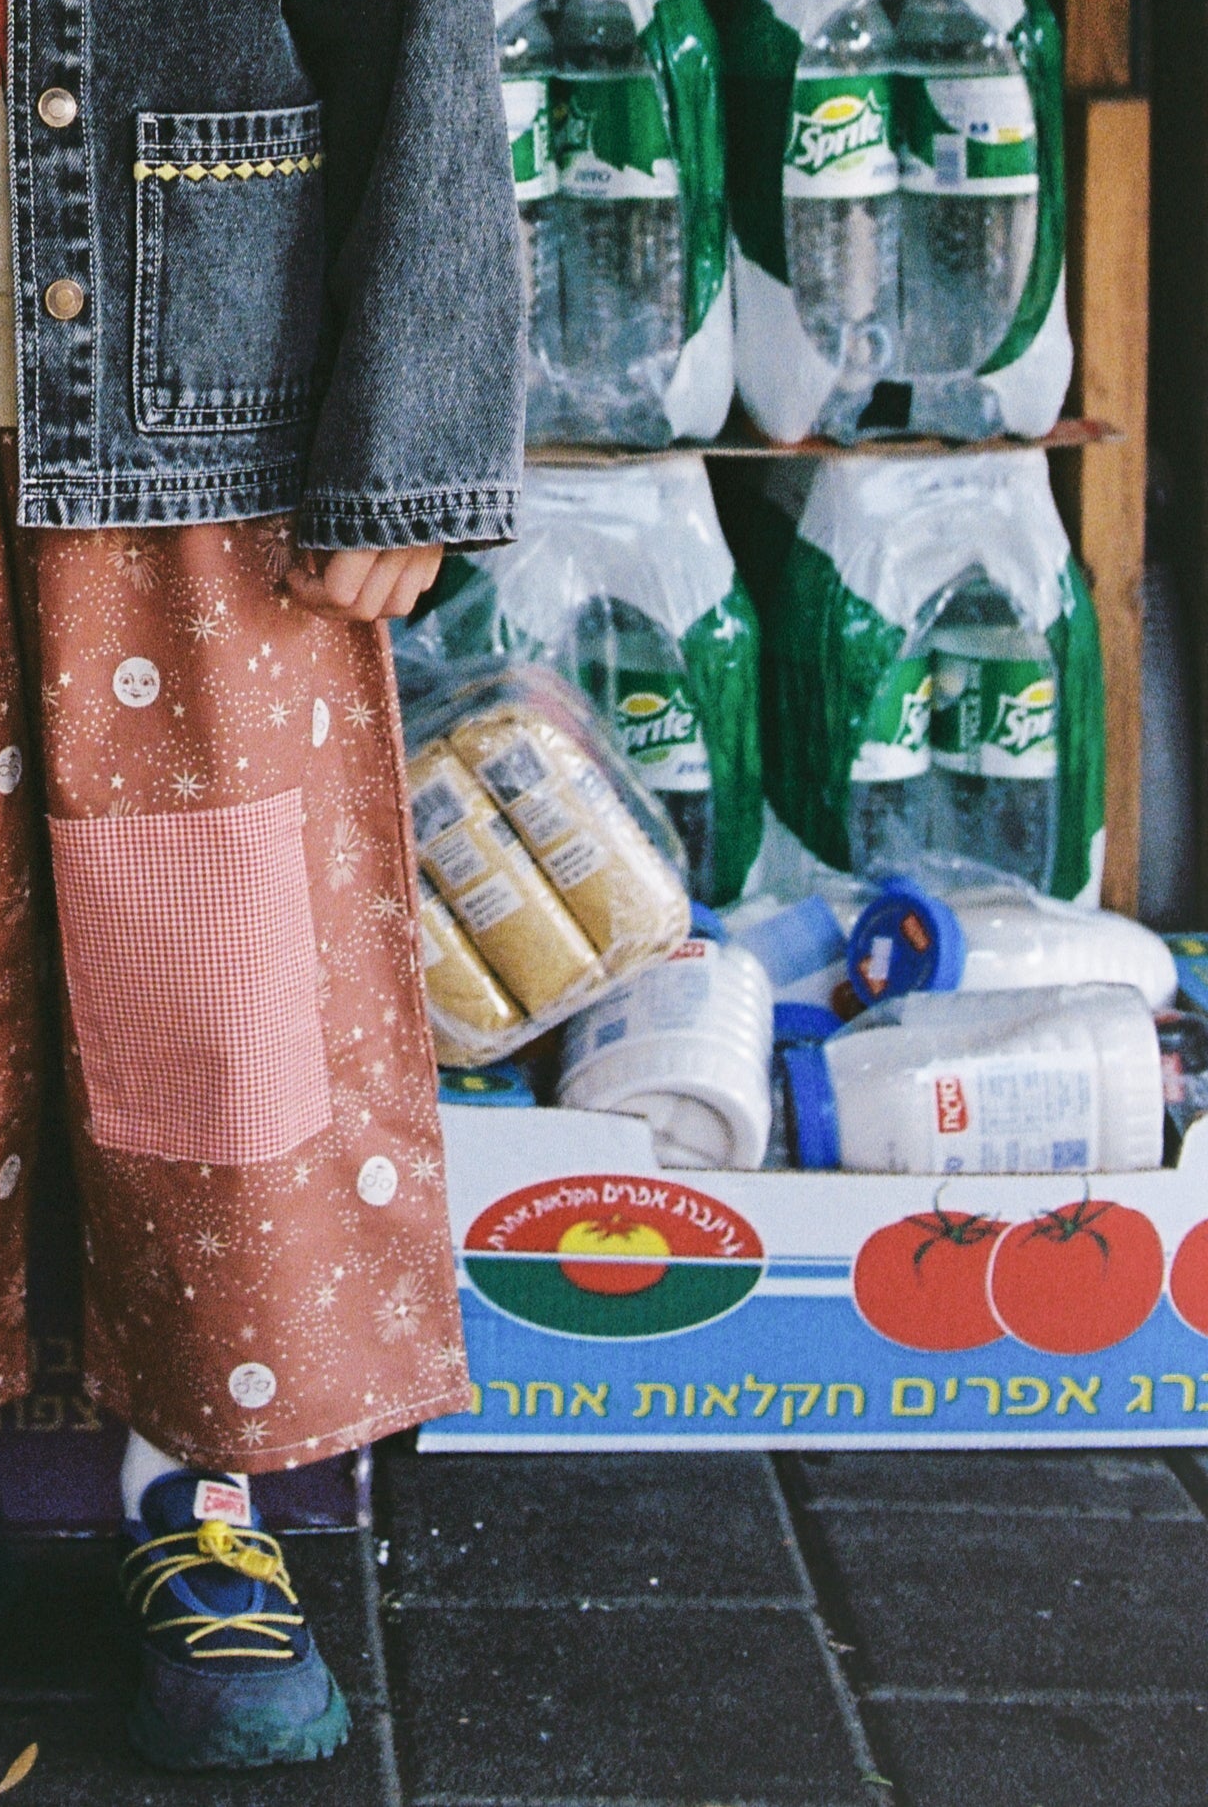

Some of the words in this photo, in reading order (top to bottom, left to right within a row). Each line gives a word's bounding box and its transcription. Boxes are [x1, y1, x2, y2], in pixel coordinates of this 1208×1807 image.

[794, 108, 883, 169] Sprite
[602, 1182, 669, 1209] אפרים
[632, 1373, 866, 1427] חקלאות
[891, 1374, 1100, 1417] אפרים
